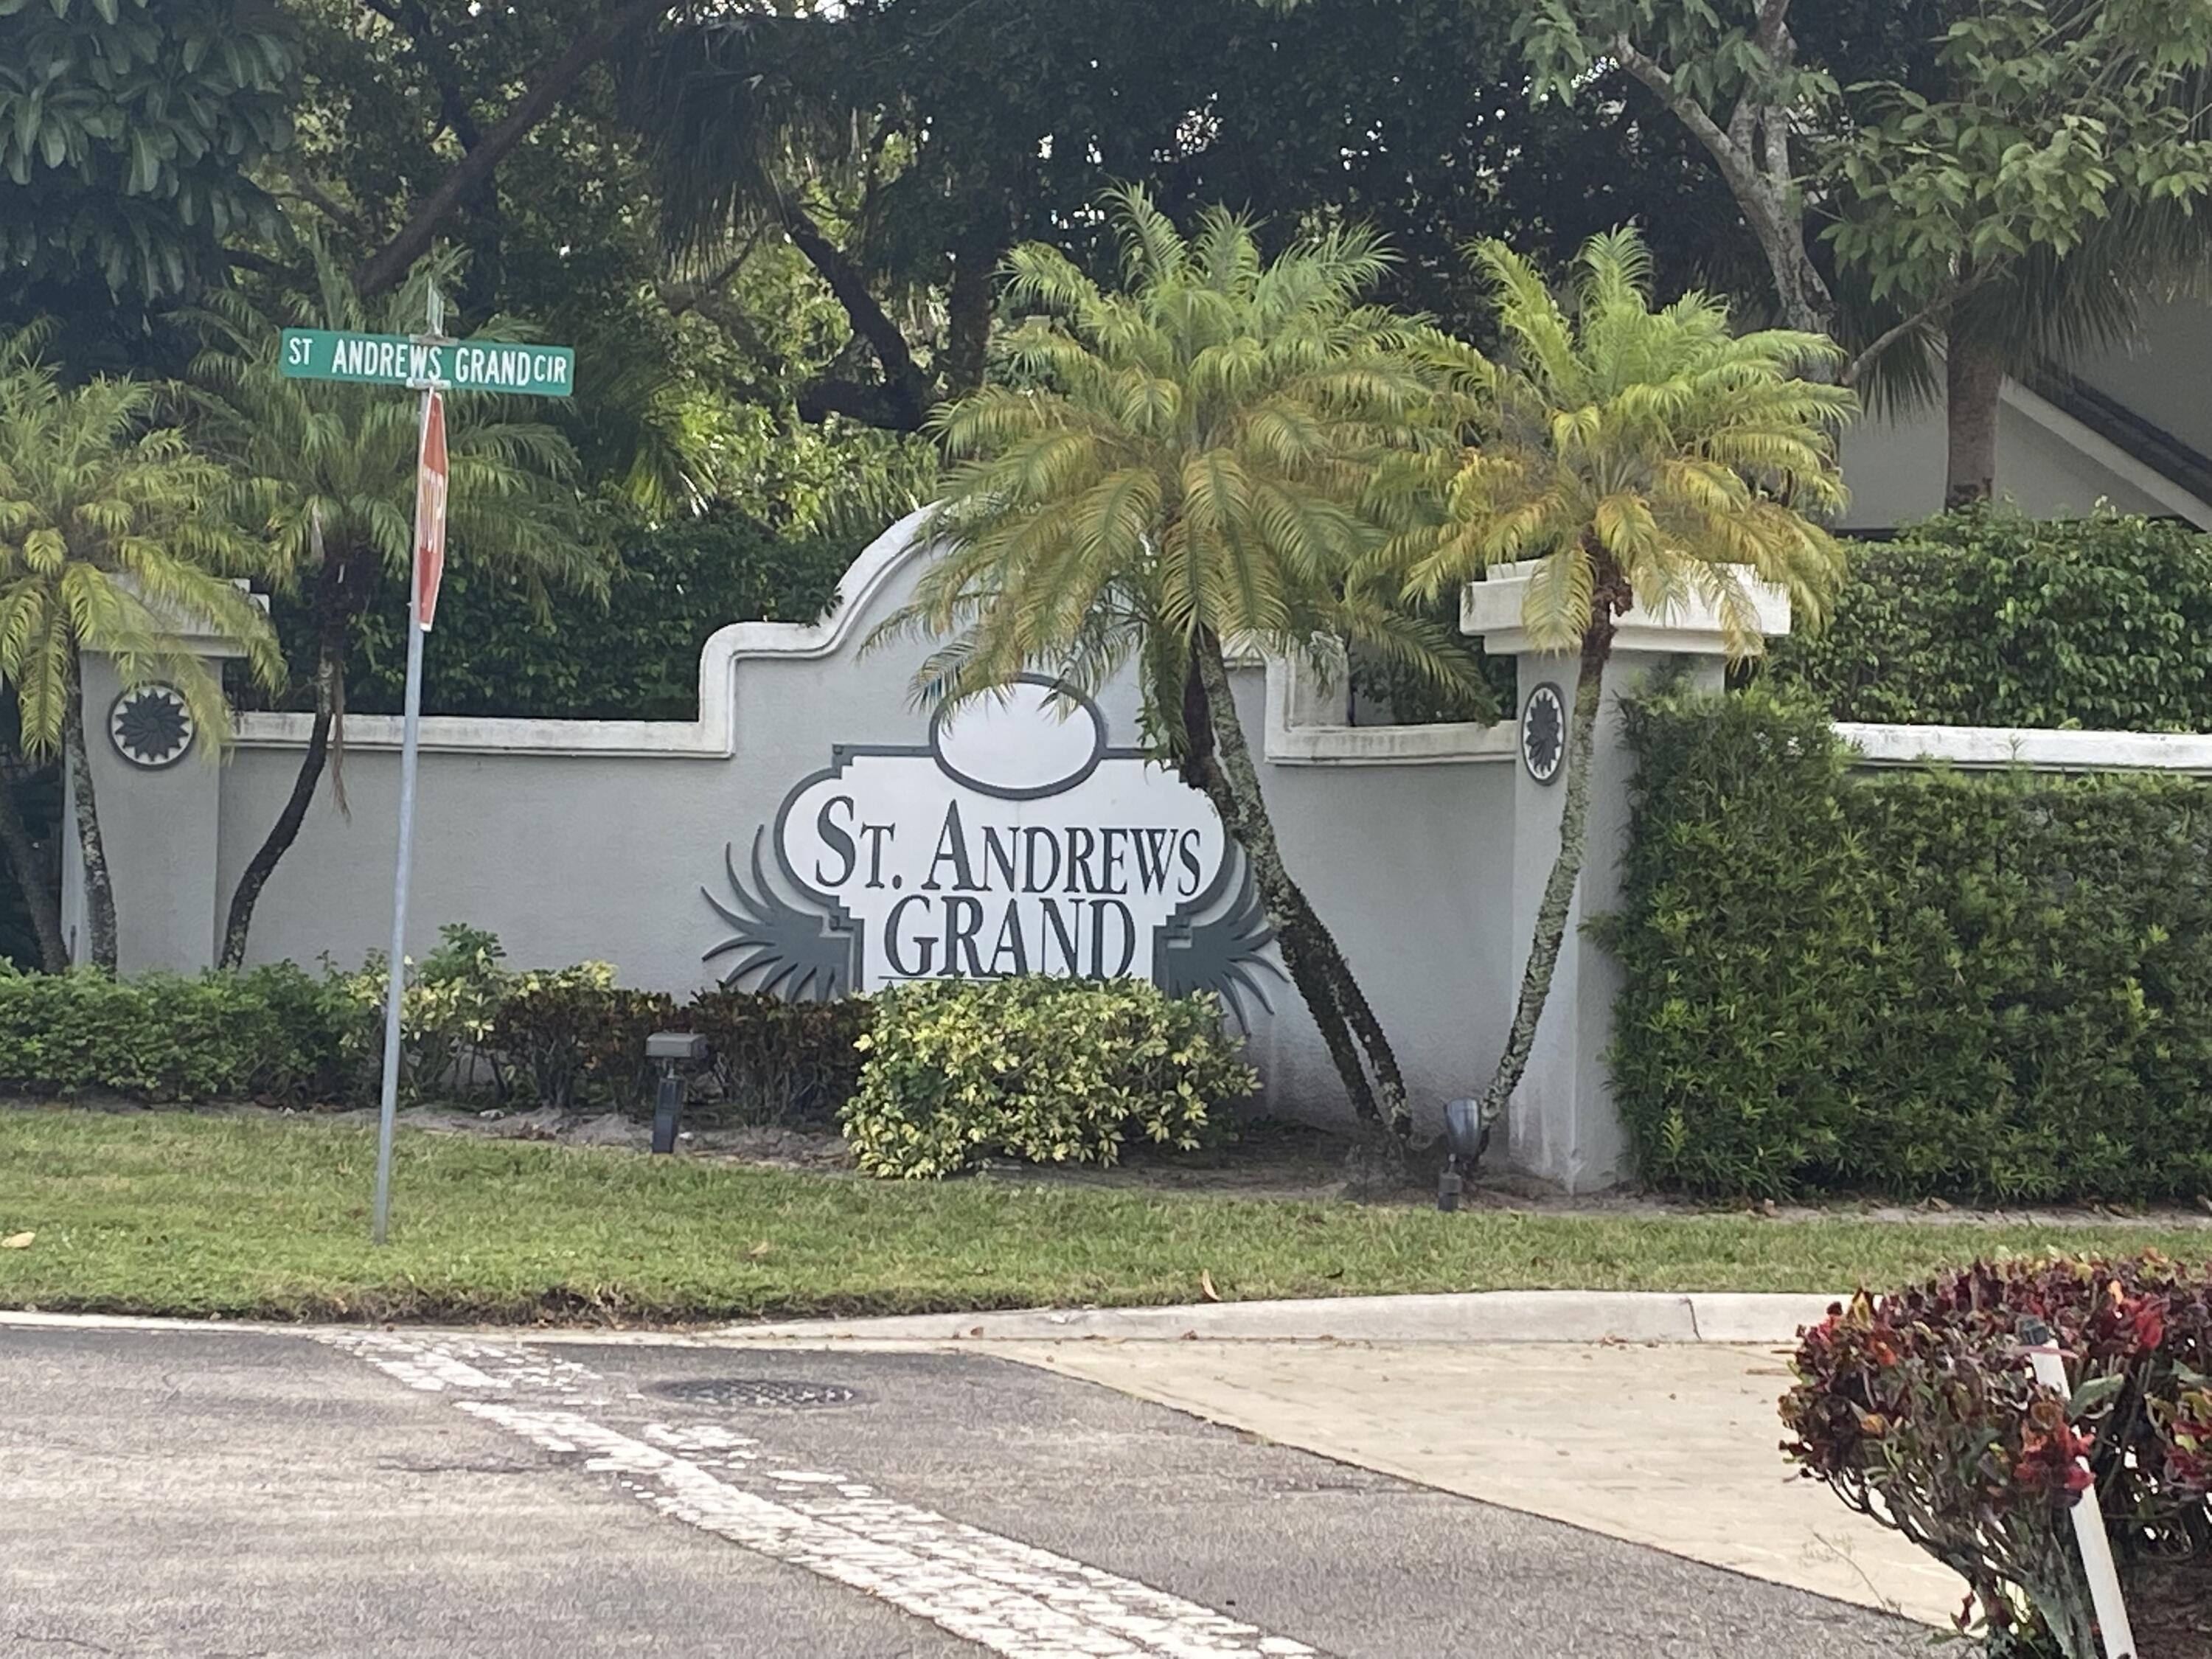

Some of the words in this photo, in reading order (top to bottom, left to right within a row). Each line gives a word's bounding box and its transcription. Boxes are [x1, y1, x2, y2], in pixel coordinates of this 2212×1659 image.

[288, 337, 313, 365] ST
[332, 338, 442, 380] ANDREWS
[455, 347, 531, 386] GRAND
[534, 355, 566, 383] CIR
[921, 799, 1201, 896] ANDREWS
[885, 894, 1136, 980] GRAND
